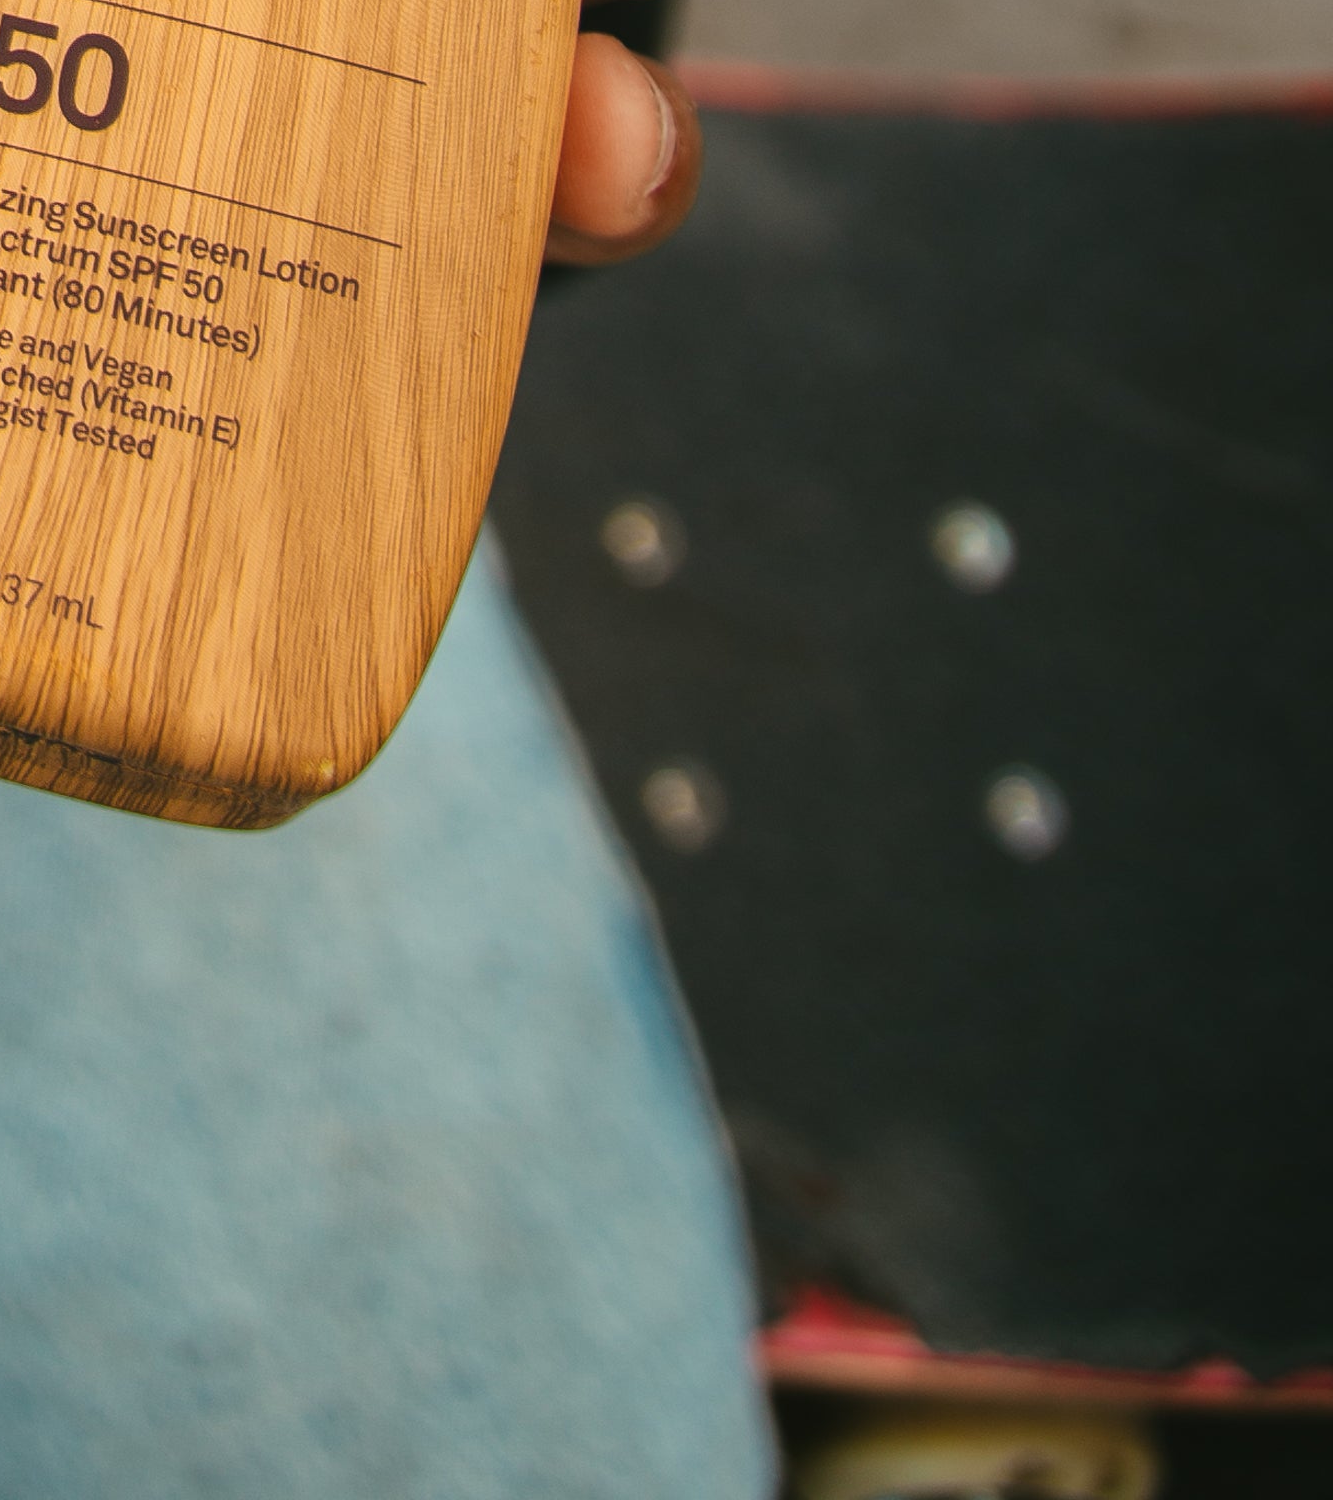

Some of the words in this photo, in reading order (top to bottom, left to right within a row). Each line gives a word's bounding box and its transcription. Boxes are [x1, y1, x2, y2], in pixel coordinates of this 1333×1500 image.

[74, 201, 250, 270] Sunscreen
[258, 247, 360, 301] Lotion
[109, 249, 176, 289] SPF
[182, 272, 224, 305] 50
[52, 275, 105, 314] (80
[111, 288, 261, 361] Minutes)
[19, 327, 78, 366] and
[83, 342, 173, 391] Vegan
[54, 410, 156, 459] Tested
[80, 380, 205, 438] (Vitamin
[211, 415, 242, 450] E)
[51, 592, 103, 630] mL
